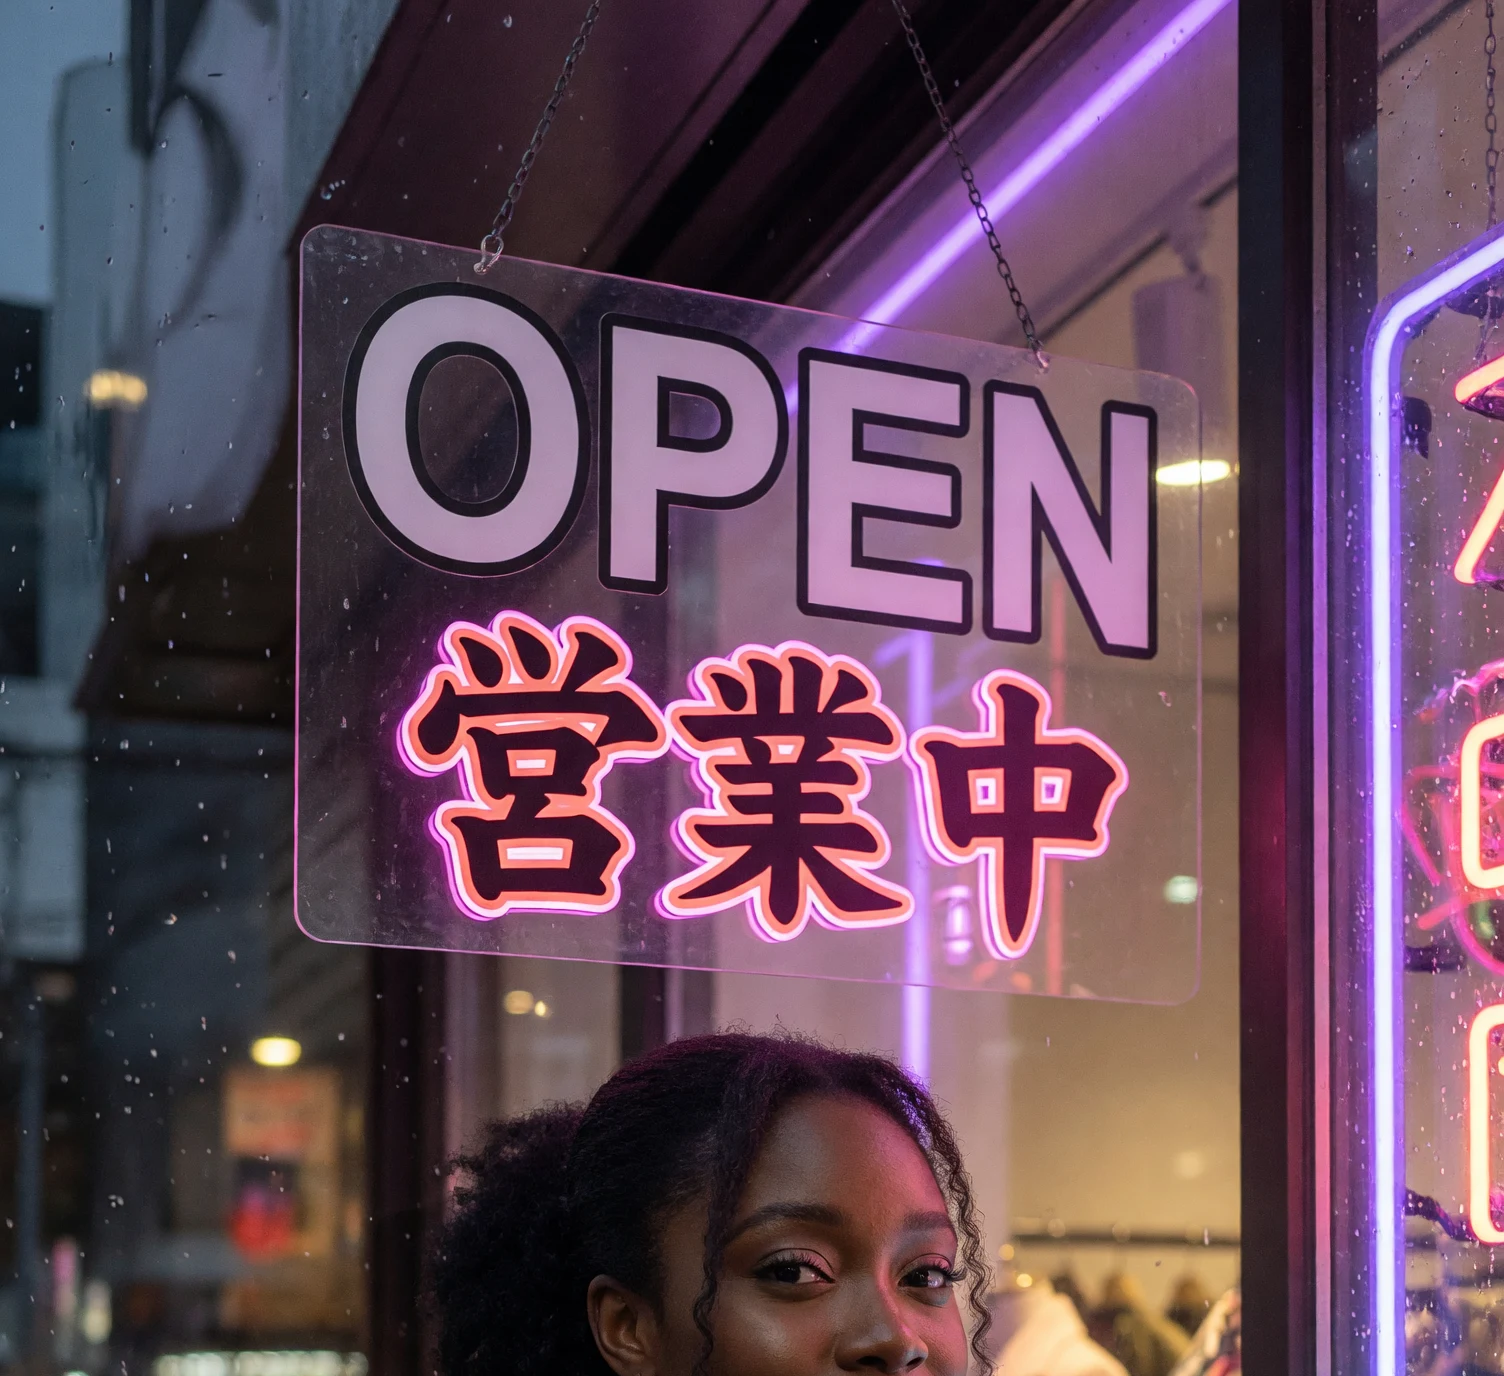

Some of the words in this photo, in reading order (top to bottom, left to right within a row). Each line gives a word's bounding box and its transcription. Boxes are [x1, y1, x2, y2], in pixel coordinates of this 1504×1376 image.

[342, 281, 1158, 660] OPEN
[400, 610, 1129, 960] 営業中
